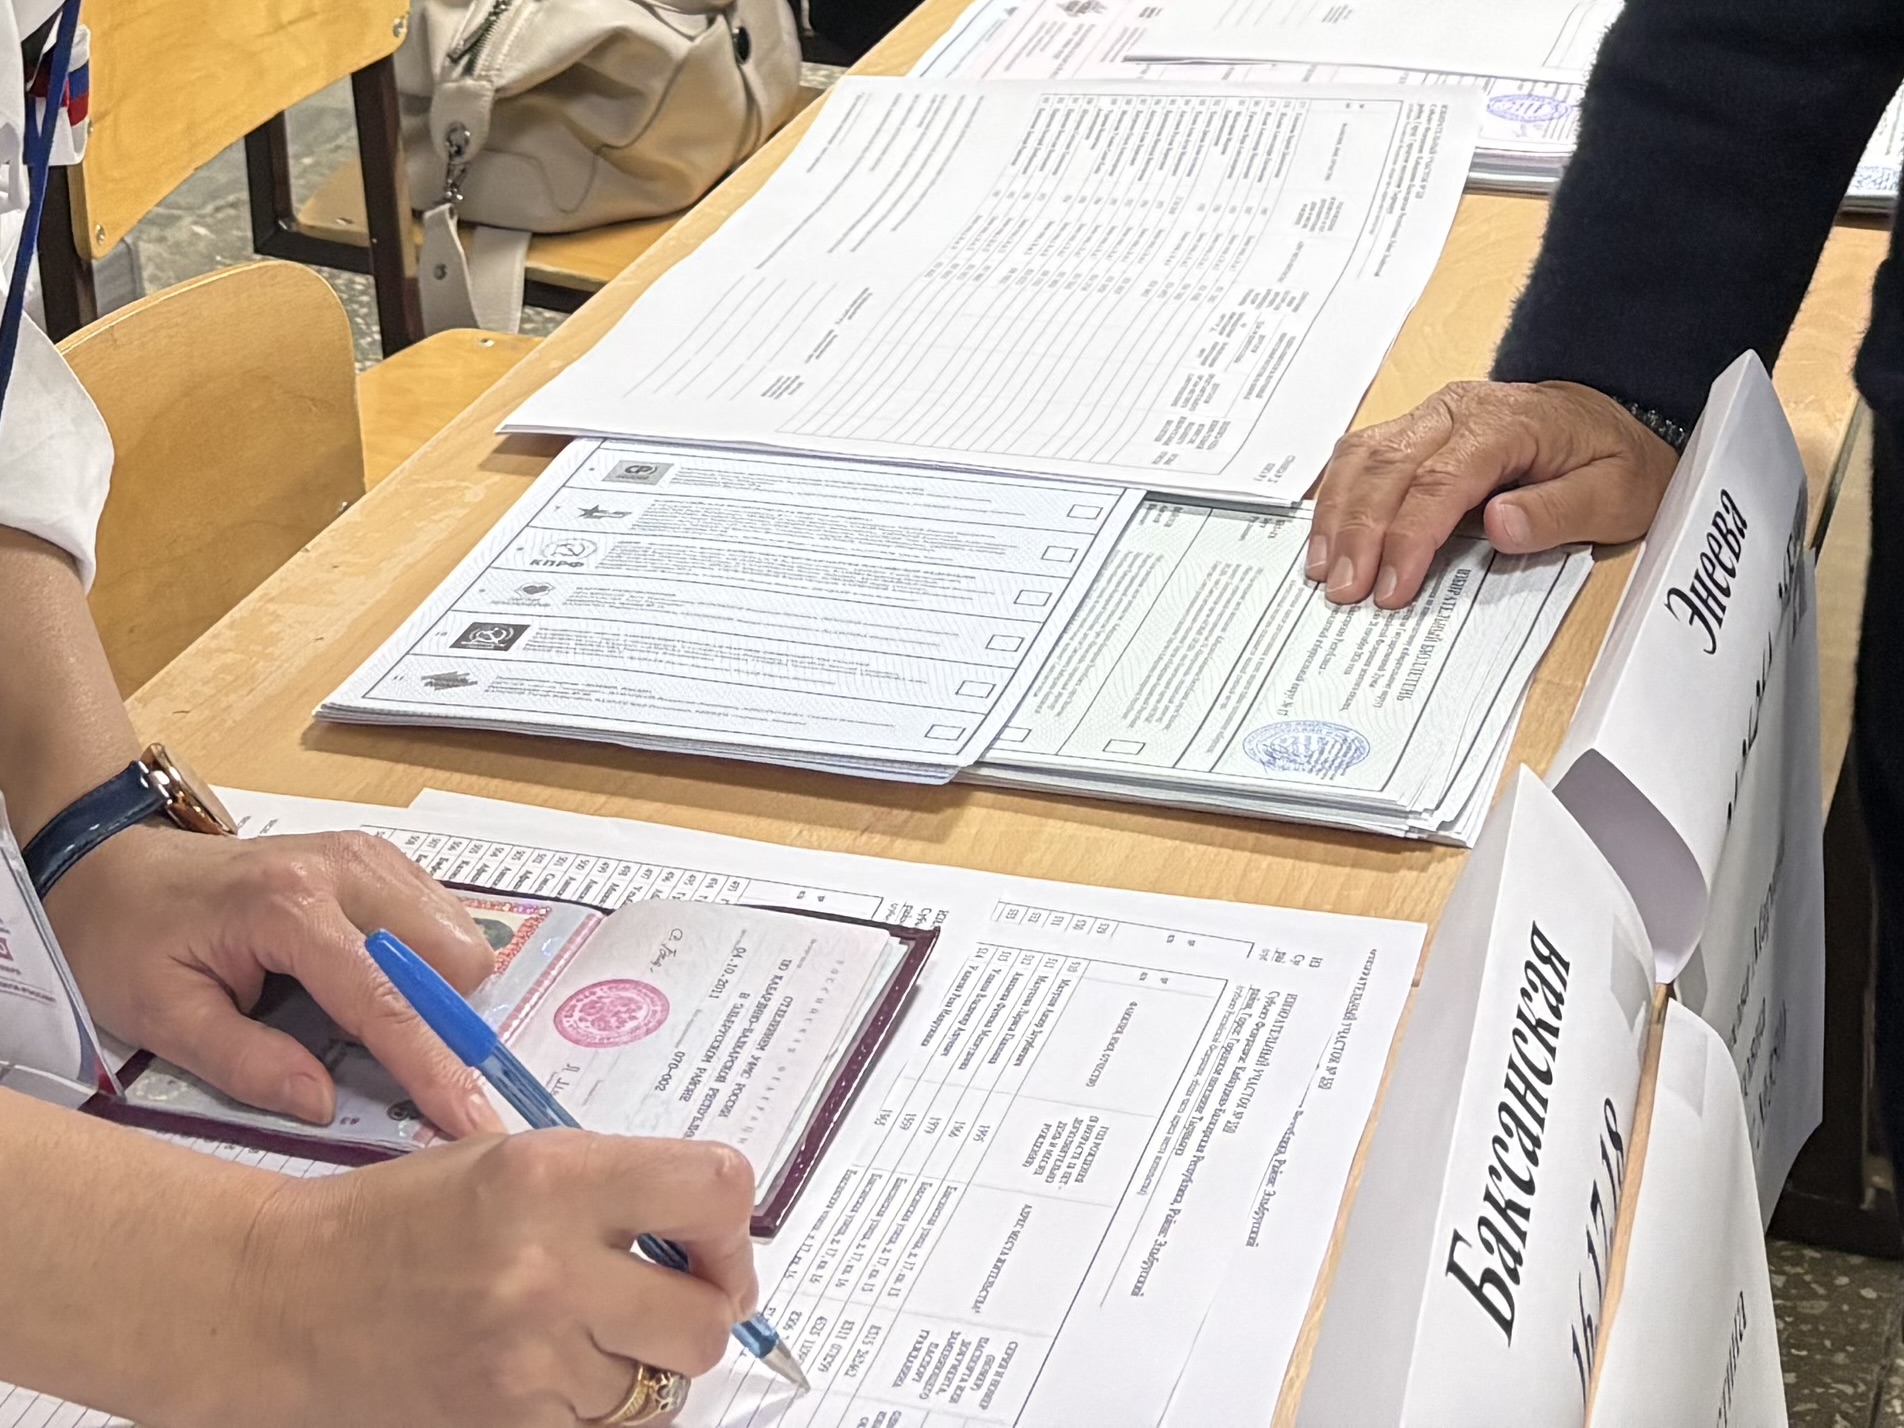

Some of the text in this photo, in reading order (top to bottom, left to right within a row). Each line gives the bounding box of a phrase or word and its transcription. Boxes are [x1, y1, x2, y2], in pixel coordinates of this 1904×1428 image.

[530, 559, 585, 568] КПРФ
[1664, 489, 1748, 655] Энеева
[1394, 567, 1473, 702] ИЗБИРАТЕЛЬНЫЙ БЮЛЛЕТЕНЬ
[707, 945, 748, 1000] 04.10.2011
[1253, 992, 1299, 1067] ИЗБИРАТЕЛЬНЫЙ
[1326, 1022, 1352, 1063] УЧАСТОК
[653, 1049, 686, 1092] 070-002
[678, 1066, 707, 1103] РАЙОНЕ
[1234, 1068, 1265, 1108] УЧАСТОК
[717, 1082, 746, 1118] РОССИИ
[1445, 920, 1571, 1348] Баксанская
